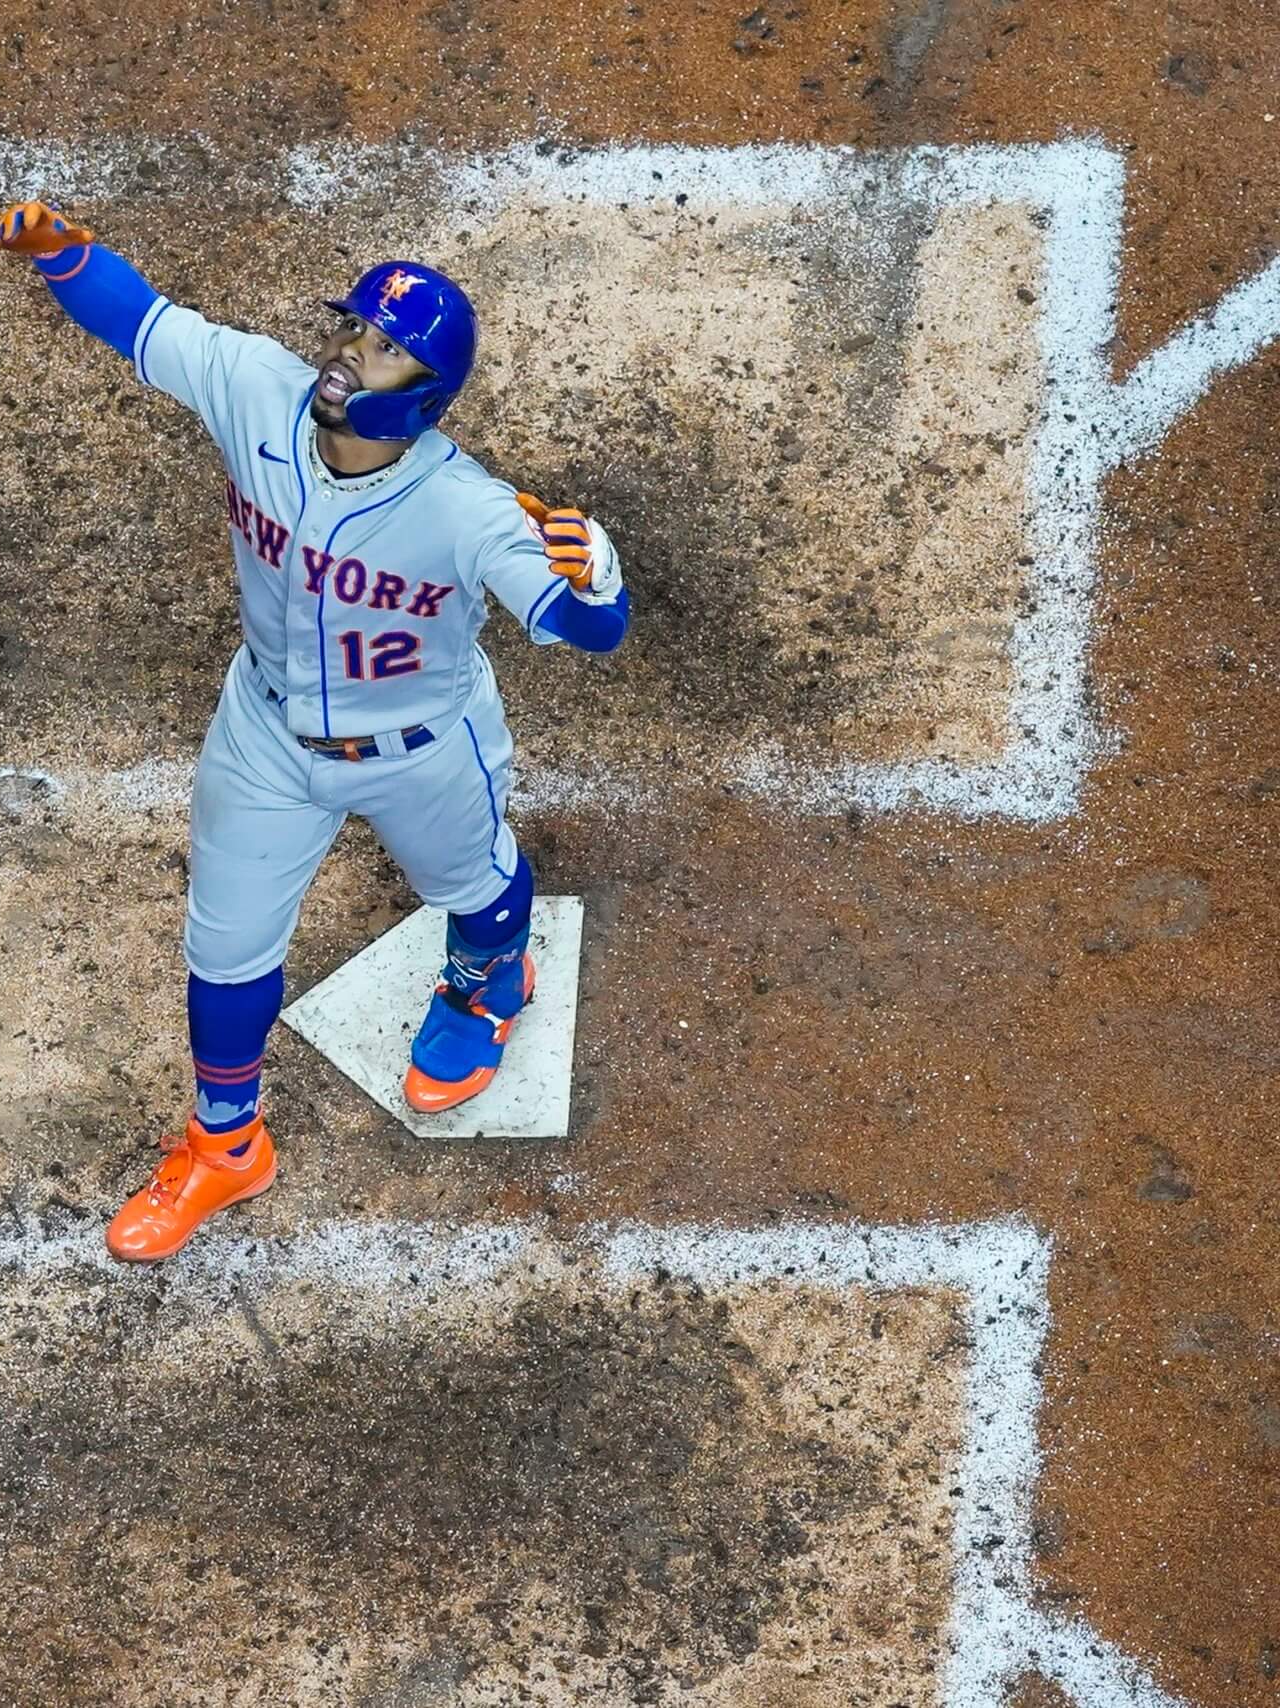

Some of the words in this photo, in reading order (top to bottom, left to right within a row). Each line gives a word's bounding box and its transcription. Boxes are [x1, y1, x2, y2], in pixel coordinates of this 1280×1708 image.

[227, 478, 290, 569] NEW
[301, 544, 456, 618] YORK
[337, 630, 422, 681] 12
